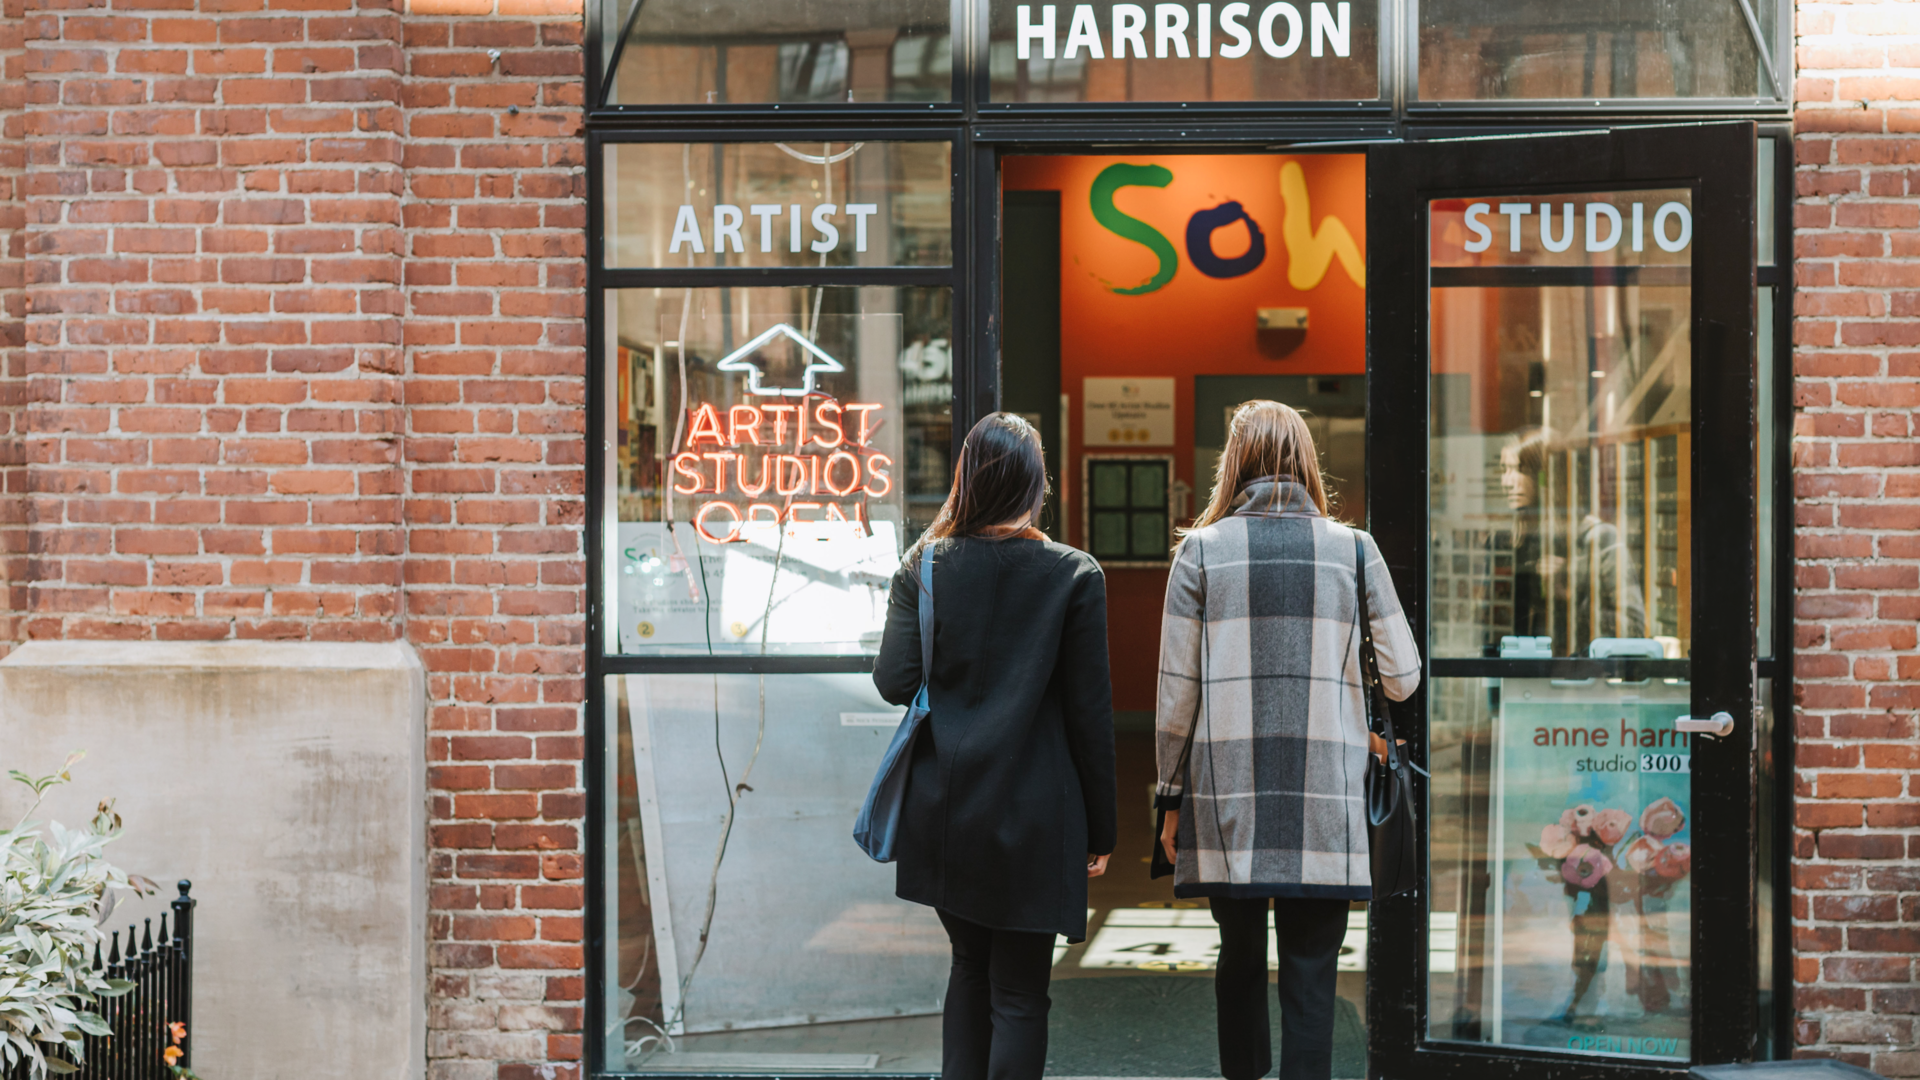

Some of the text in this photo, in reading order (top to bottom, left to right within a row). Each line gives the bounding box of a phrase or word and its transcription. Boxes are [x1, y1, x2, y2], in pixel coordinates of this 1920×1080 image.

[1016, 1, 1351, 60] HARRISON
[668, 203, 878, 254] ARTIST
[1463, 201, 1692, 253] STUDIO
[686, 402, 884, 448] ARTIST
[674, 451, 893, 498] STUDIOS
[696, 501, 863, 544] OPEN
[1533, 726, 1609, 747] anne
[1576, 754, 1637, 773] studio
[1642, 753, 1682, 773] 300
[1567, 1035, 1679, 1055] OPEN NOW
